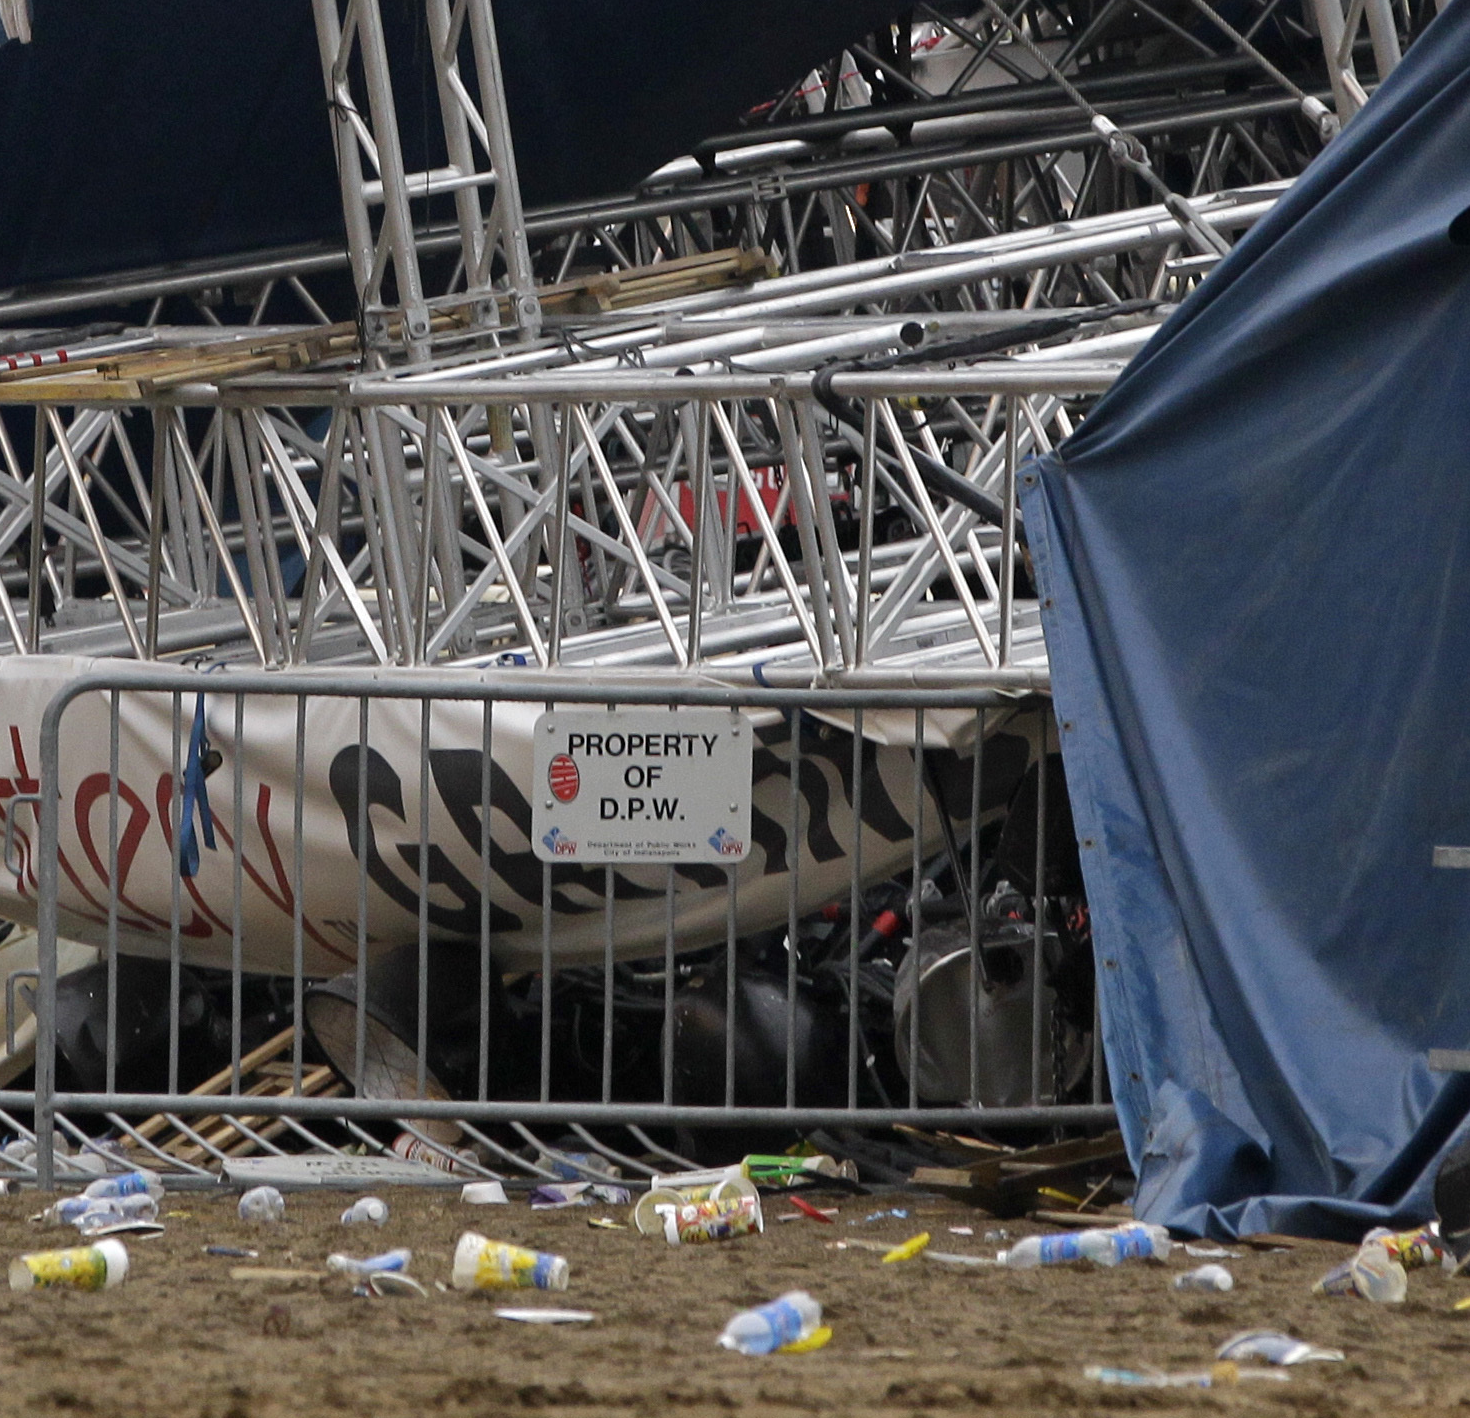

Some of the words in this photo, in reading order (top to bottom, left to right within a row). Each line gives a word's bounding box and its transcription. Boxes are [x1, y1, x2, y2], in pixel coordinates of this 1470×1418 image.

[567, 733, 719, 757] PROPERTY
[623, 765, 664, 789] OF
[599, 797, 686, 822] D.P.W.
[554, 841, 578, 855] DPW
[720, 841, 744, 855] DPW
